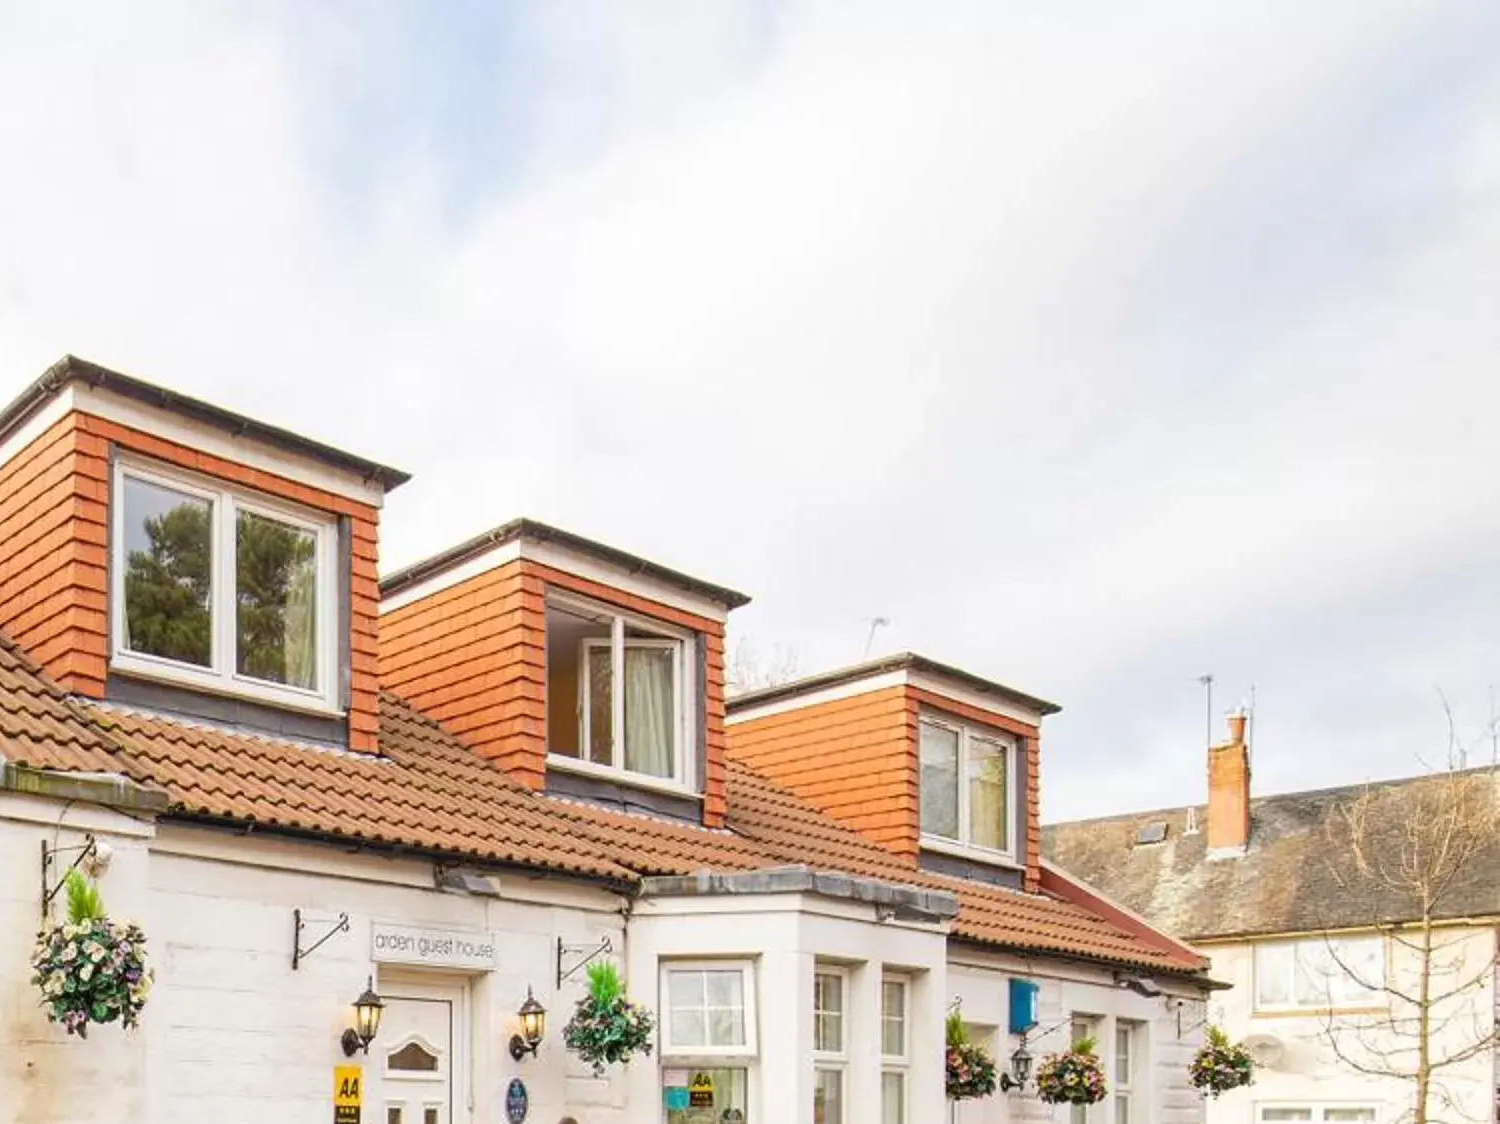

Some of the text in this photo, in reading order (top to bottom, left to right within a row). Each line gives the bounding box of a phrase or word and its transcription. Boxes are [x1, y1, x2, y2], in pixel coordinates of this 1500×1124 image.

[417, 935, 453, 957] guest
[454, 936, 493, 958] house
[340, 1077, 359, 1098] AA
